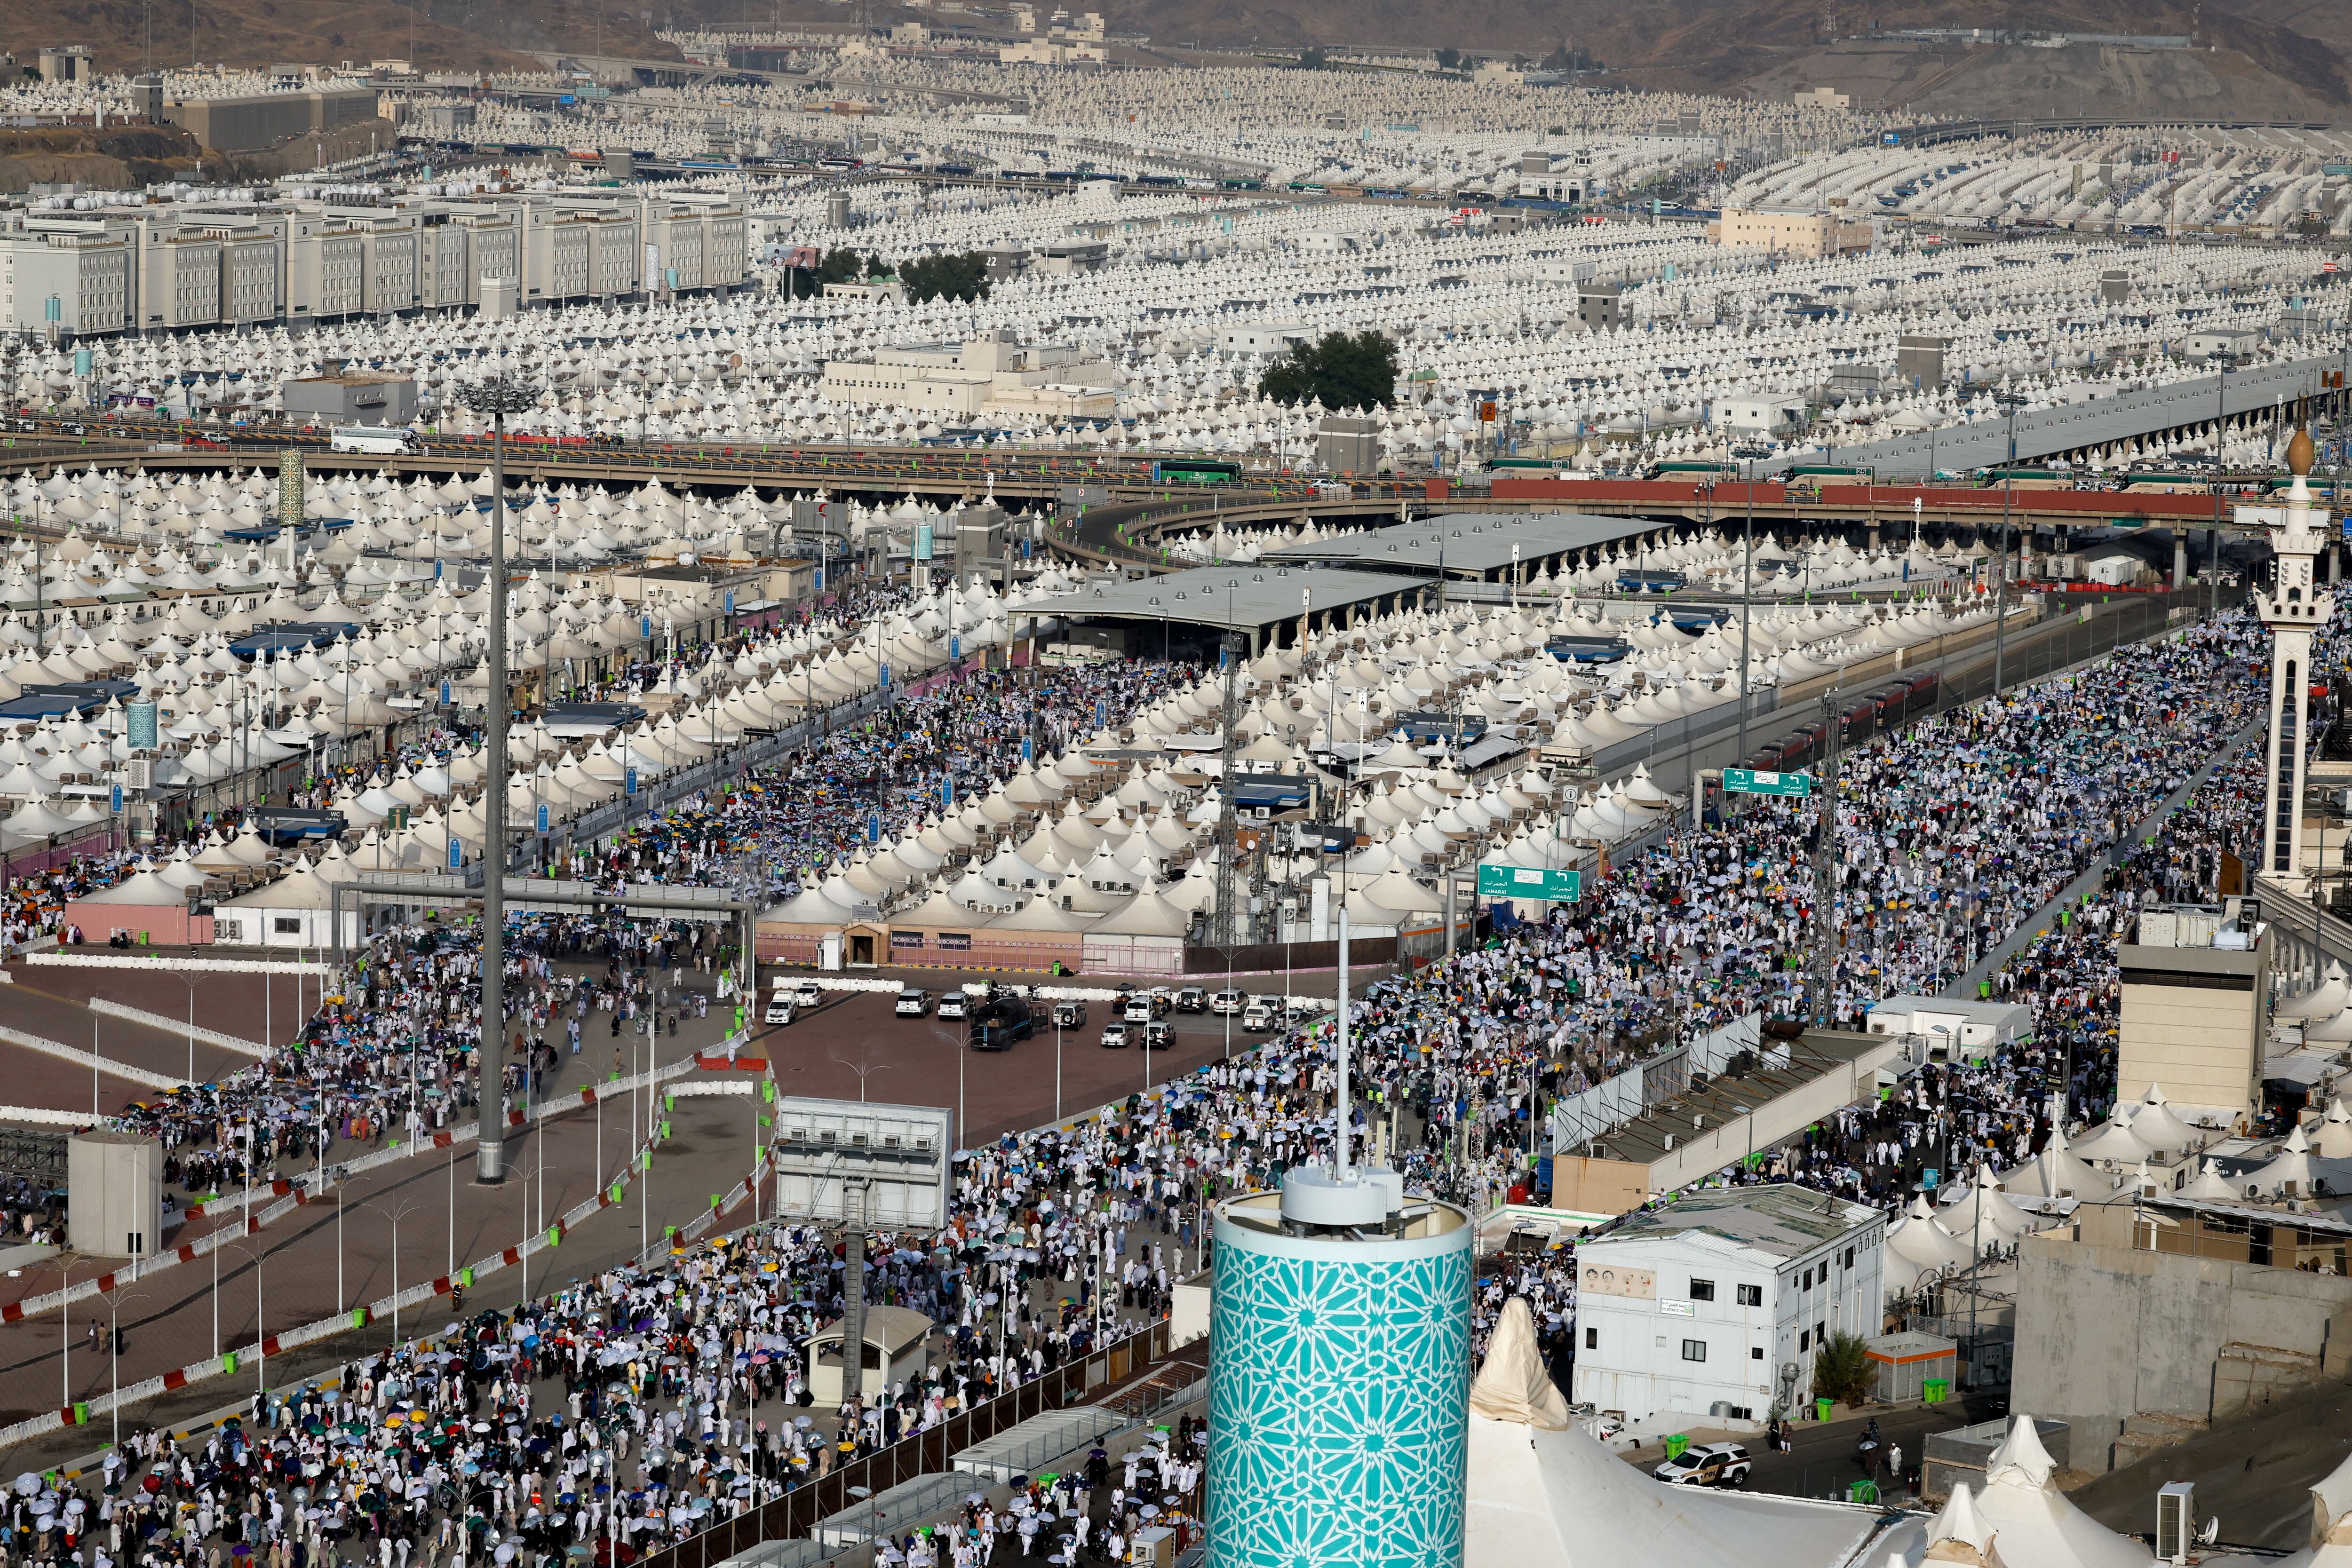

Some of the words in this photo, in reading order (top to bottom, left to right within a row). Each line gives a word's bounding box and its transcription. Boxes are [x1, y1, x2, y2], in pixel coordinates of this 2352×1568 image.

[274, 226, 278, 235] C
[302, 226, 307, 235] D
[125, 233, 129, 241] A
[154, 233, 158, 242] B
[986, 256, 996, 266] 22
